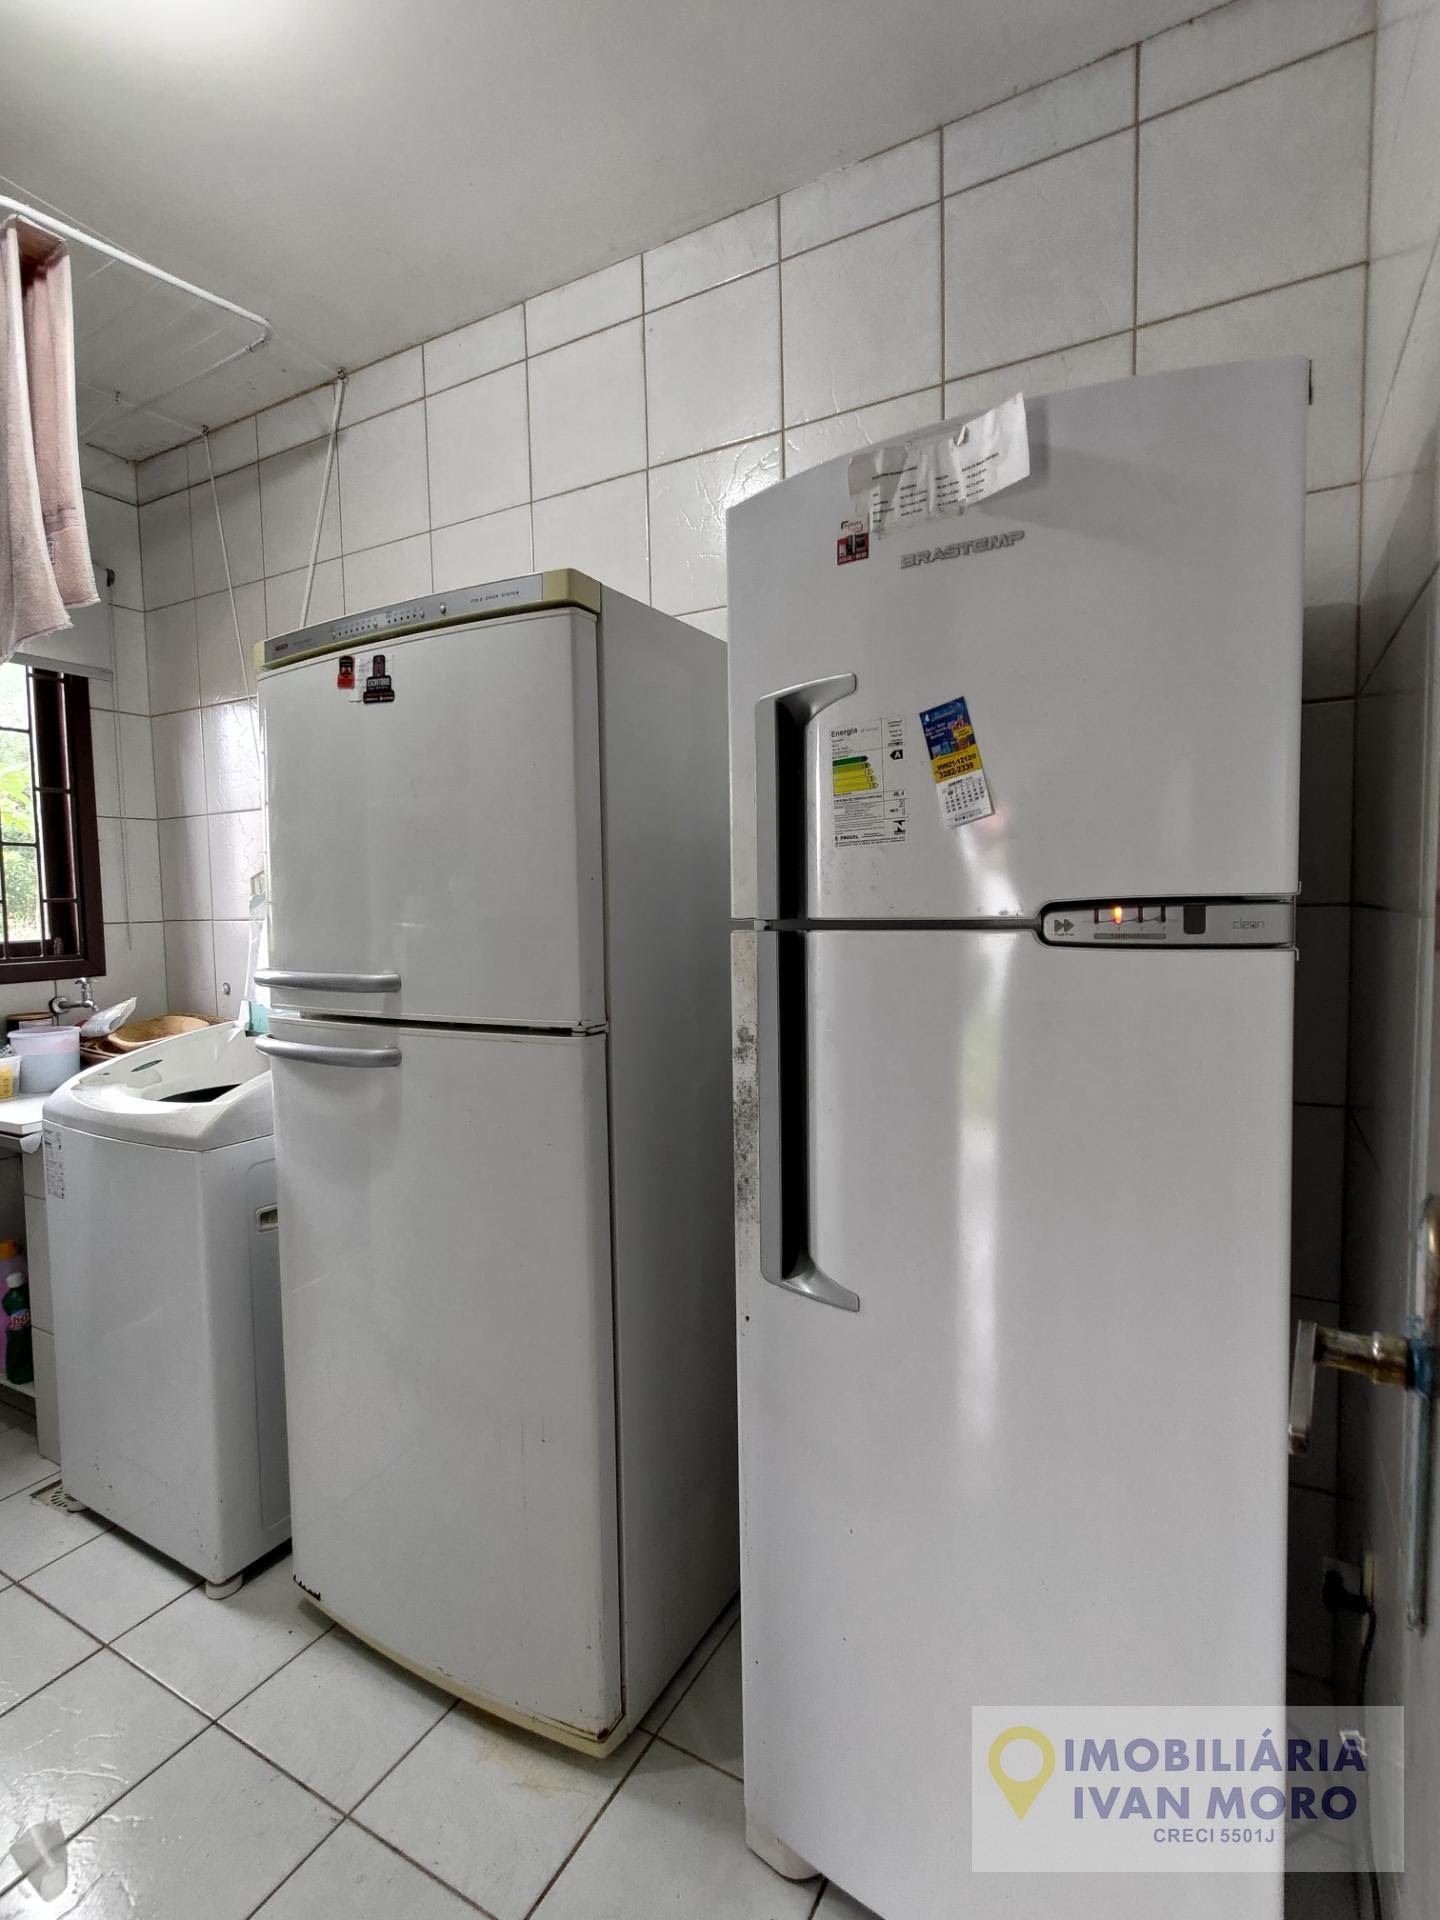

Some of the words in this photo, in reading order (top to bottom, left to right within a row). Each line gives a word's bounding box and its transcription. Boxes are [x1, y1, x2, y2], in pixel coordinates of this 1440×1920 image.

[900, 530, 1025, 569] BRASTEMP
[831, 727, 858, 738] Energia
[1232, 917, 1265, 930] clean
